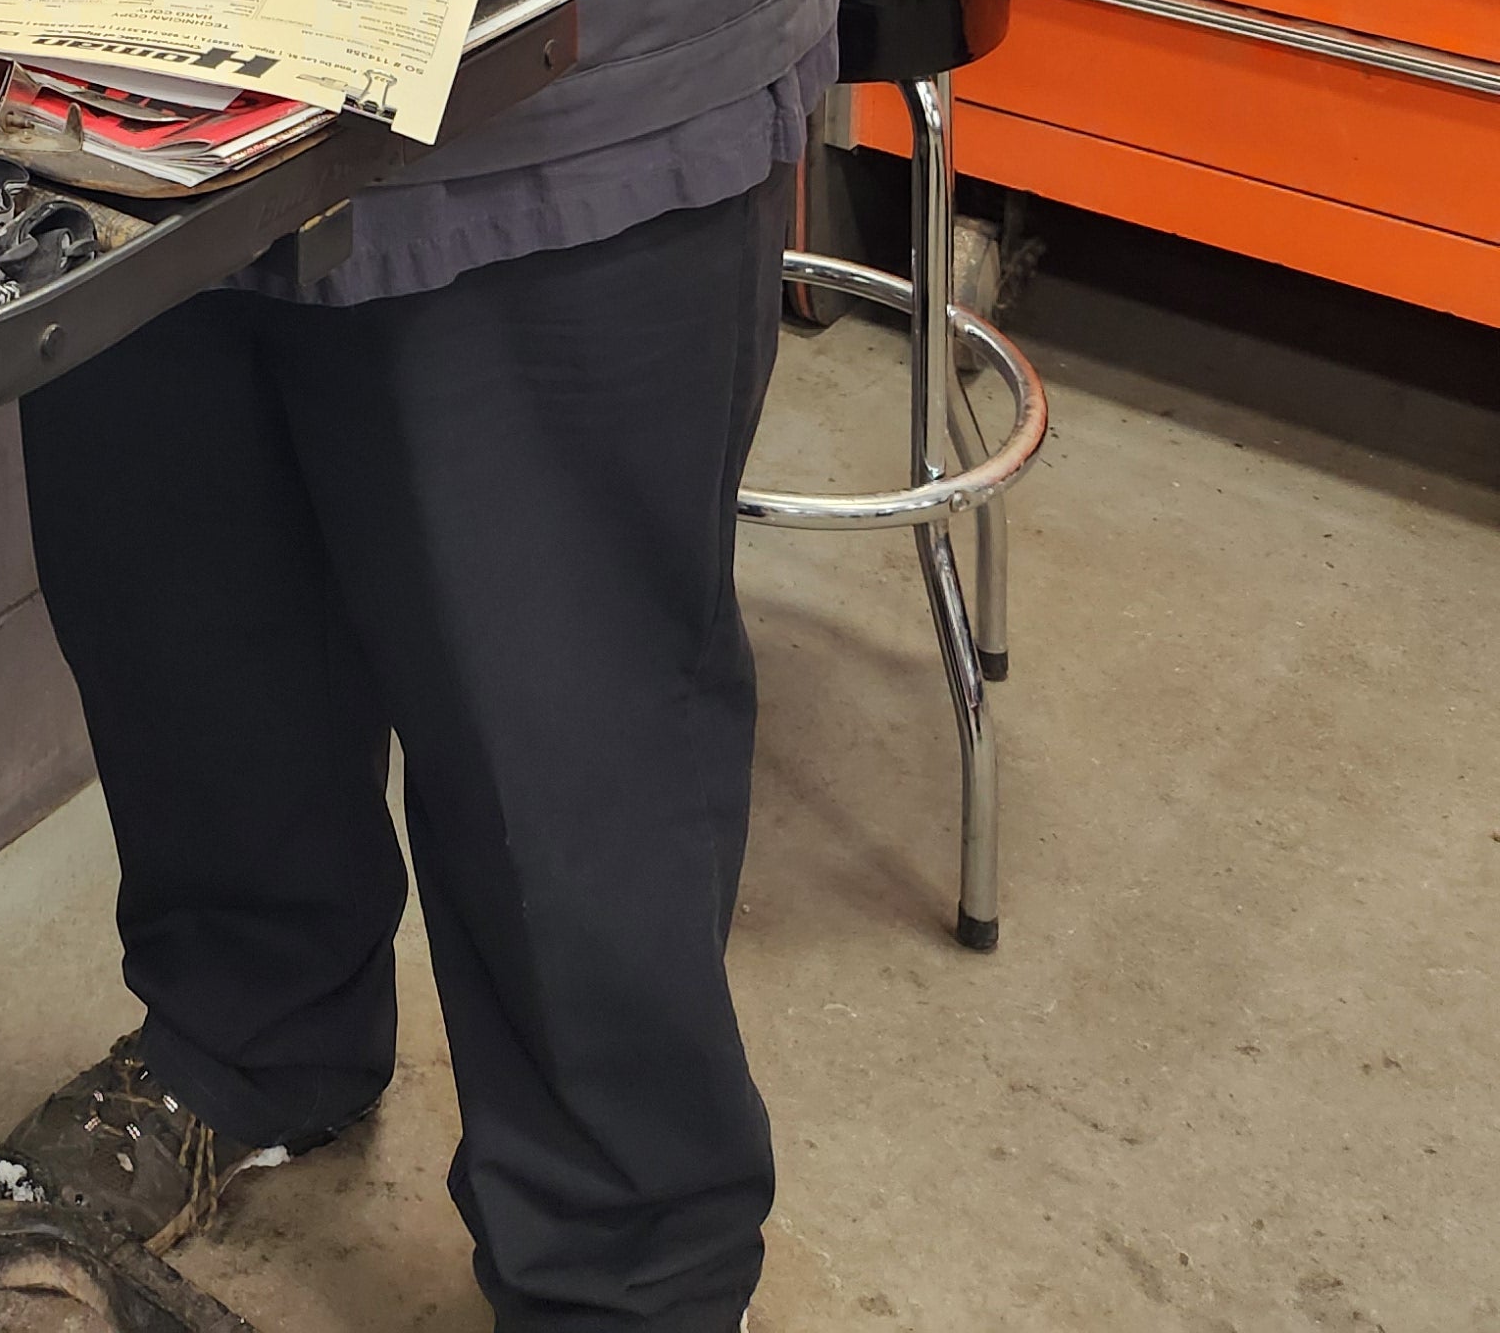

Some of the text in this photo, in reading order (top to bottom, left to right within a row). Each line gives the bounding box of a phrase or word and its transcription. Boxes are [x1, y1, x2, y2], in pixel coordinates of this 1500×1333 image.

[139, 8, 214, 21] HARD COPY
[151, 15, 229, 30] TECHNICIAN
[30, 29, 281, 79] Homan
[404, 64, 425, 76] SO
